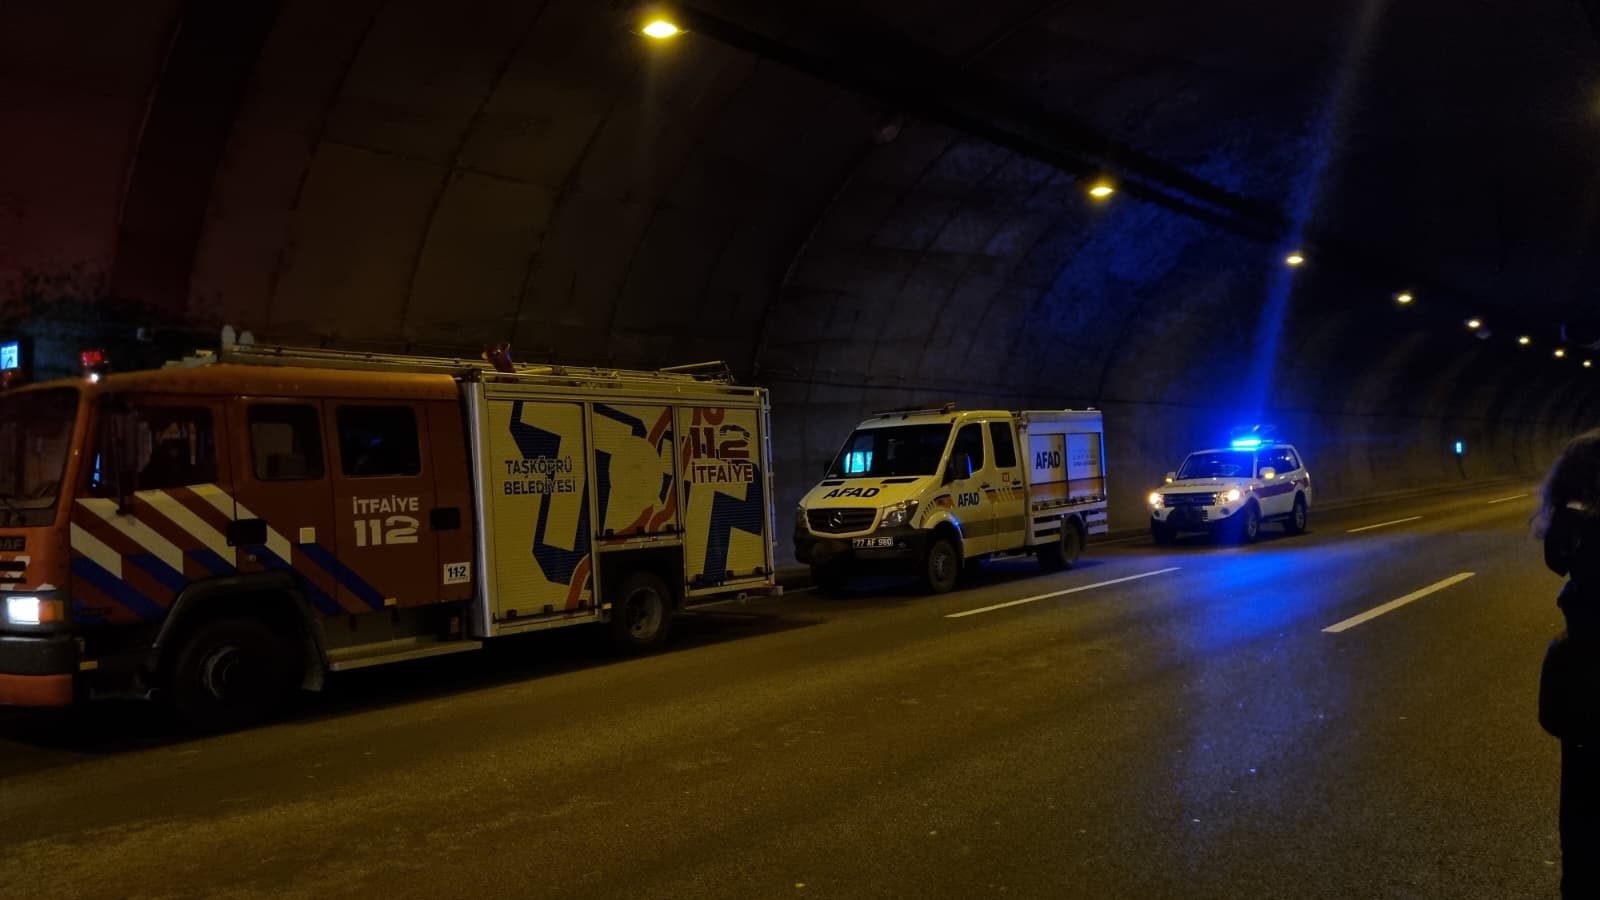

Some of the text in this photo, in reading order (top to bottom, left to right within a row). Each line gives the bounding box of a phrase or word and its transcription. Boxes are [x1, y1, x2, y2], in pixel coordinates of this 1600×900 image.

[689, 424, 750, 459] 112
[505, 455, 573, 479] TAŞKÖPRÜ
[1035, 451, 1061, 469] AFAD
[691, 461, 753, 483] İTFAİYE
[823, 487, 881, 499] AFAD
[957, 492, 980, 507] AFAD
[352, 494, 420, 515] İTFAİYE
[353, 515, 420, 547] 112
